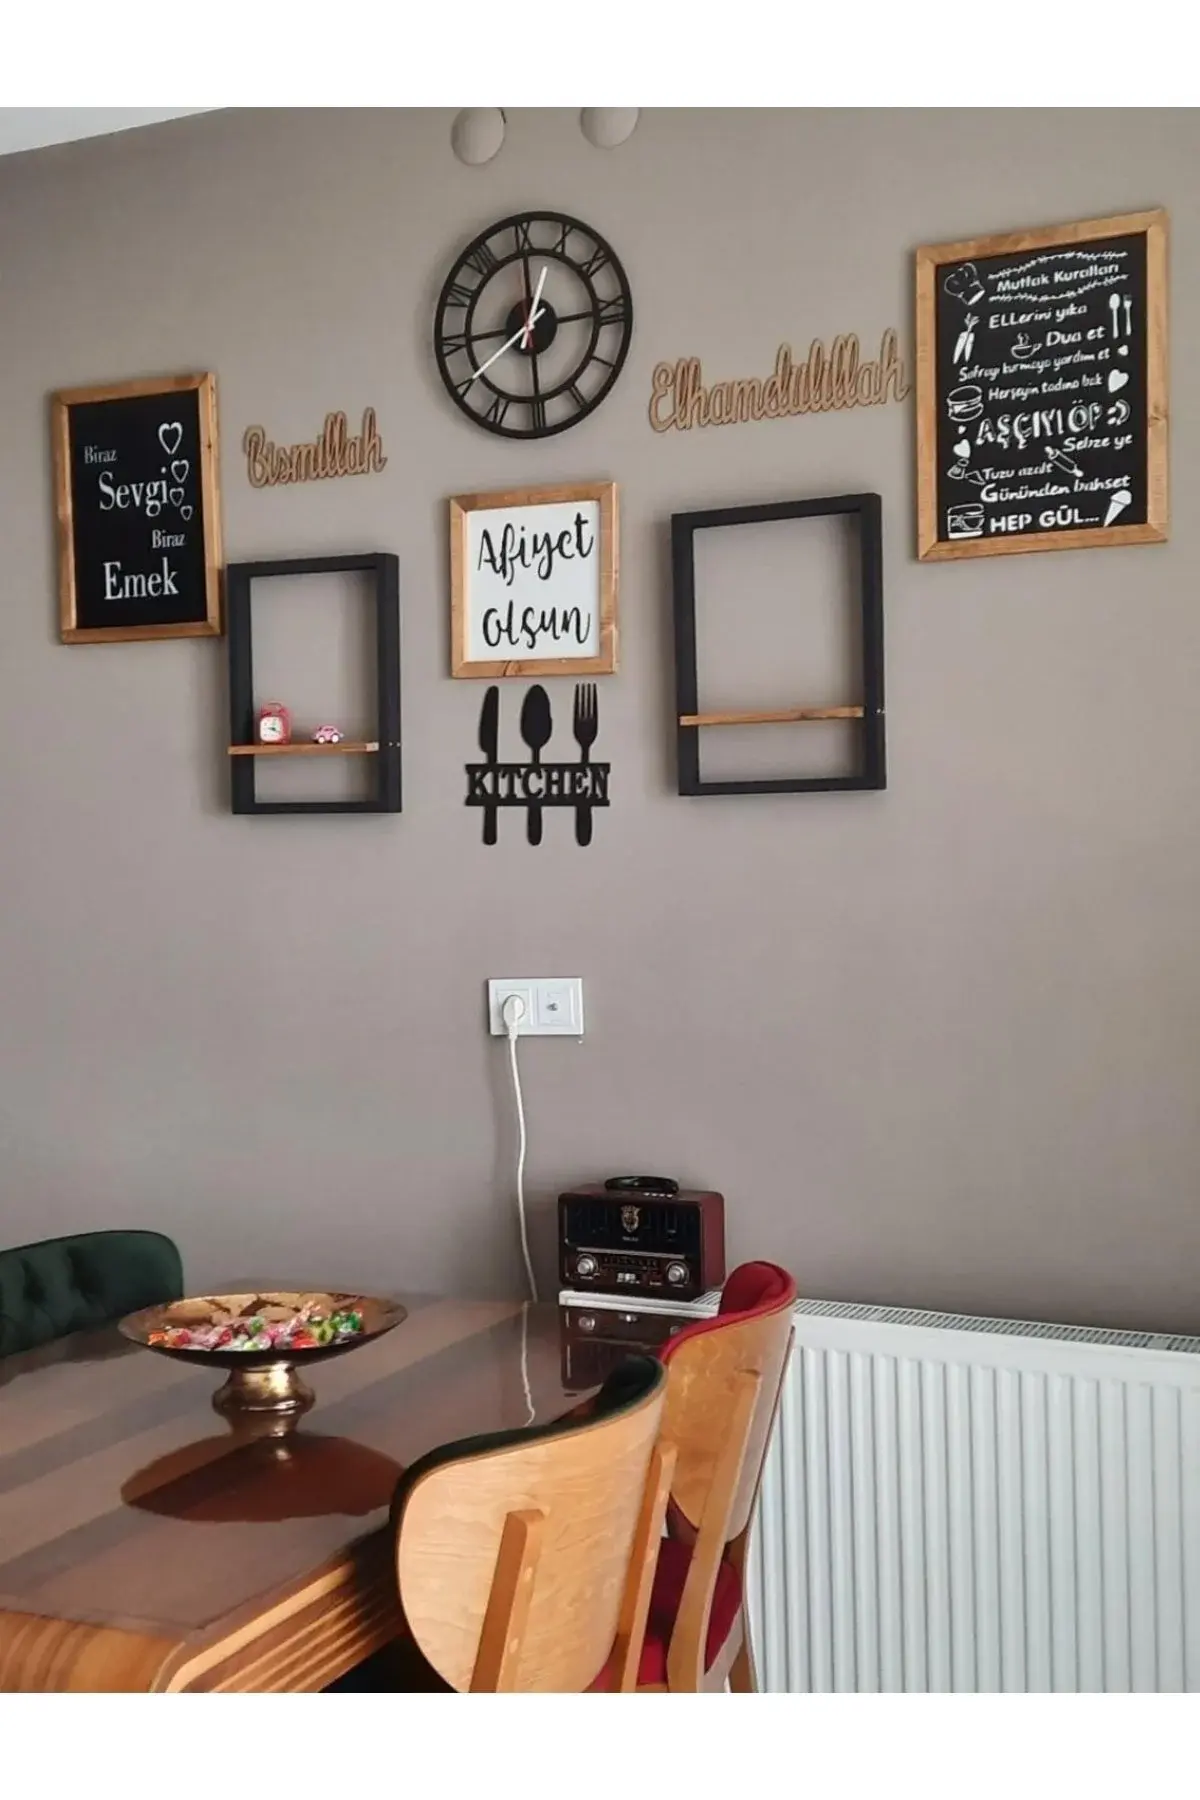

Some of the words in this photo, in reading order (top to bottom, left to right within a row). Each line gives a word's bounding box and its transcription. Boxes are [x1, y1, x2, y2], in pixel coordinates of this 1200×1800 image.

[1046, 331, 1082, 347] Dua
[1086, 325, 1107, 340] et
[1097, 348, 1111, 360] et
[1081, 372, 1103, 388] bak
[1067, 399, 1103, 432] ÖP
[84, 446, 118, 465] Biraz
[243, 407, 388, 488] Bismillah
[1062, 435, 1111, 453] Sebze
[1113, 434, 1133, 450] ye
[982, 466, 1015, 481] Tuzu
[1018, 462, 1055, 477] azalt
[98, 467, 169, 517] Sevgi
[980, 482, 1071, 503] Gününden
[1073, 475, 1132, 493] bahset
[989, 512, 1033, 534] HEP
[1038, 505, 1100, 529] GÜL...
[151, 529, 186, 549] Biraz
[477, 511, 594, 587] Afiyet
[103, 556, 179, 601] Emek
[465, 764, 610, 806] KITCHEN
